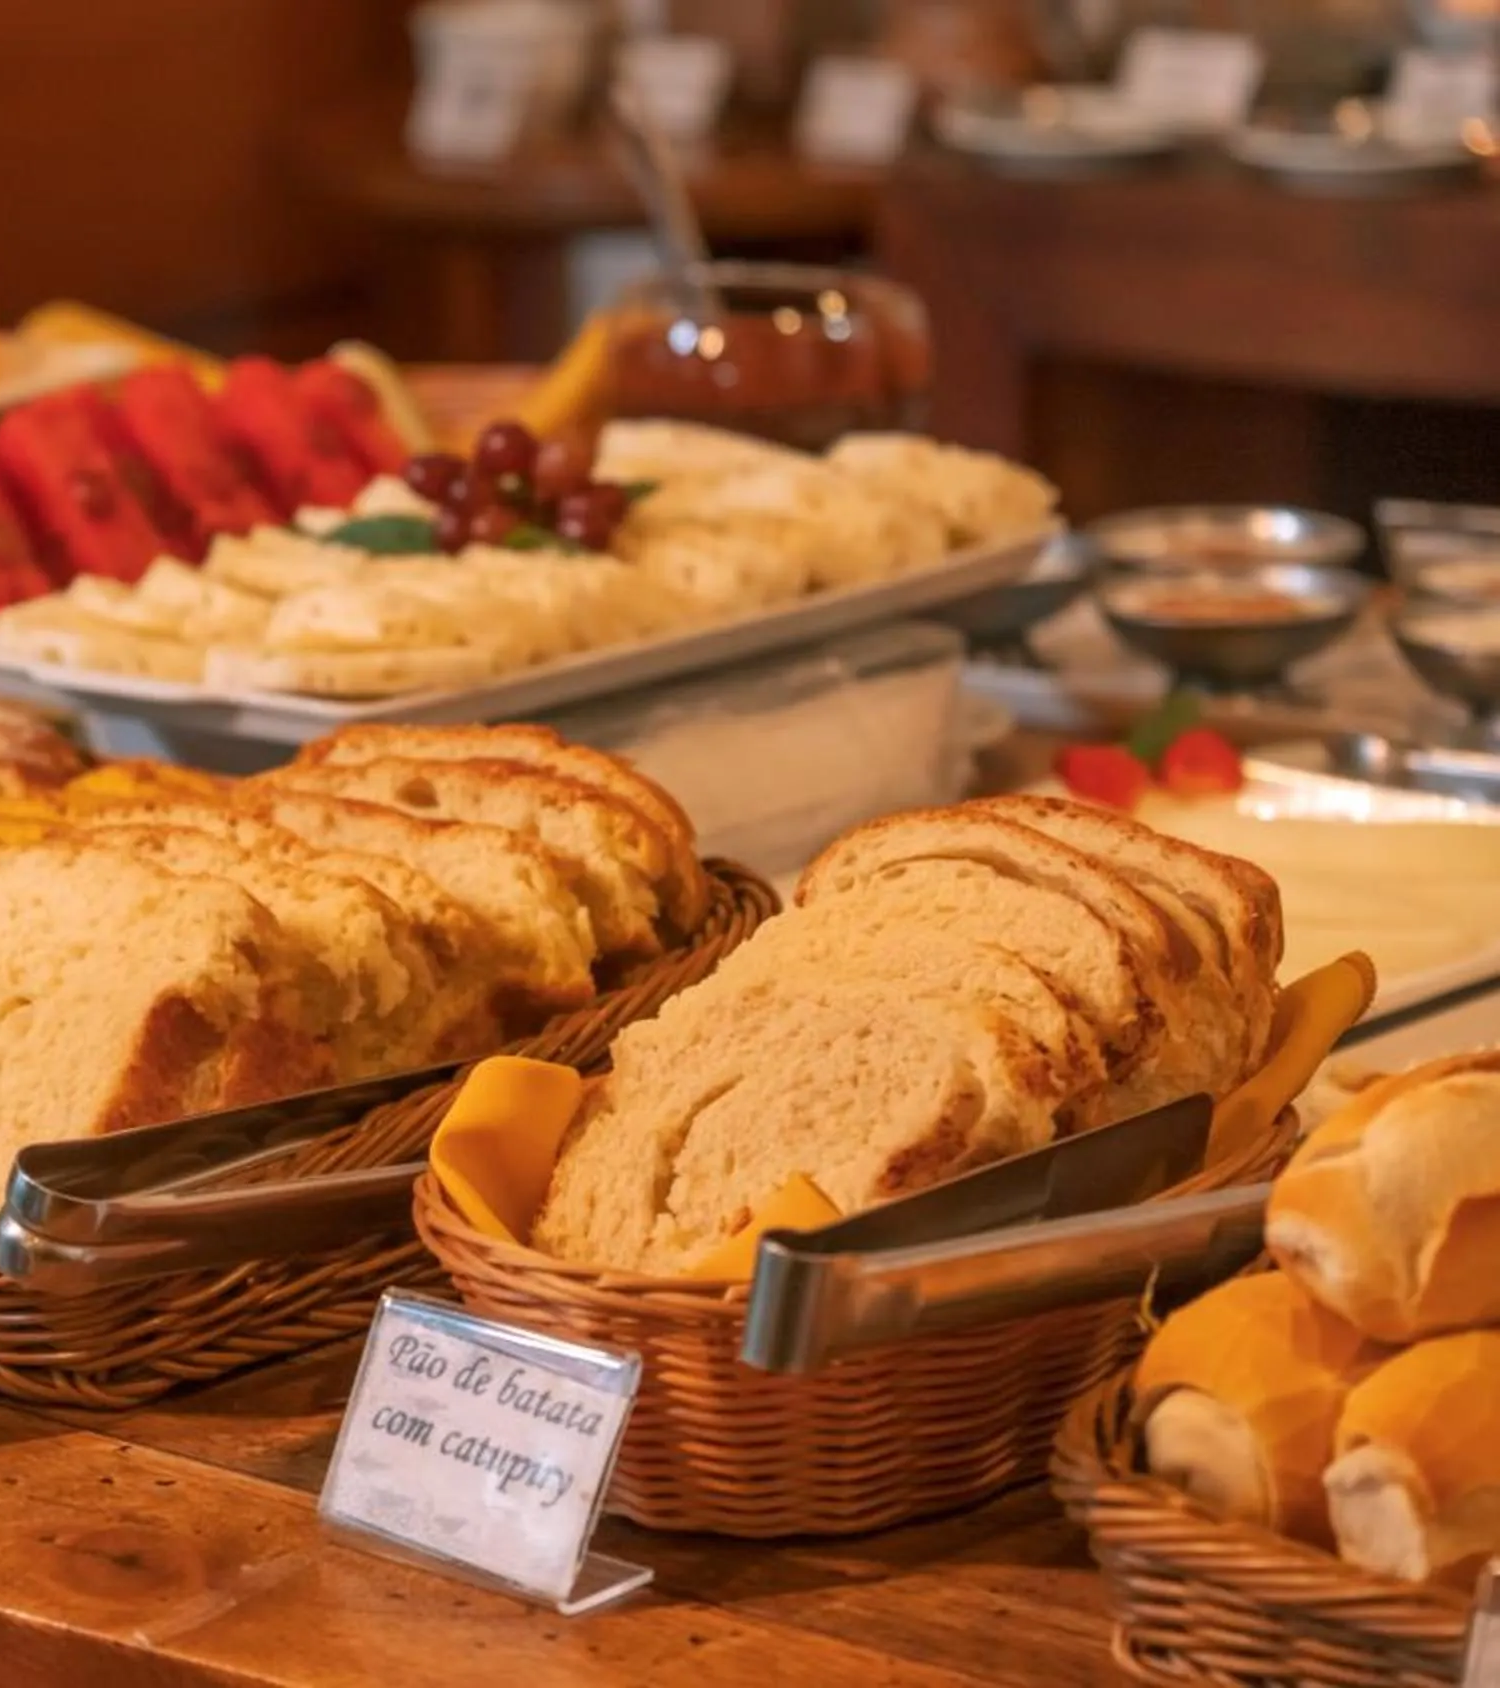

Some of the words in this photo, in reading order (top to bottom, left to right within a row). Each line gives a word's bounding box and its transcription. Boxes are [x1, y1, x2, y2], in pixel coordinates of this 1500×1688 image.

[389, 1334, 448, 1380] Pão
[452, 1353, 493, 1397] de
[496, 1368, 604, 1438] batata
[371, 1405, 435, 1448] com
[440, 1429, 575, 1509] catupiry
